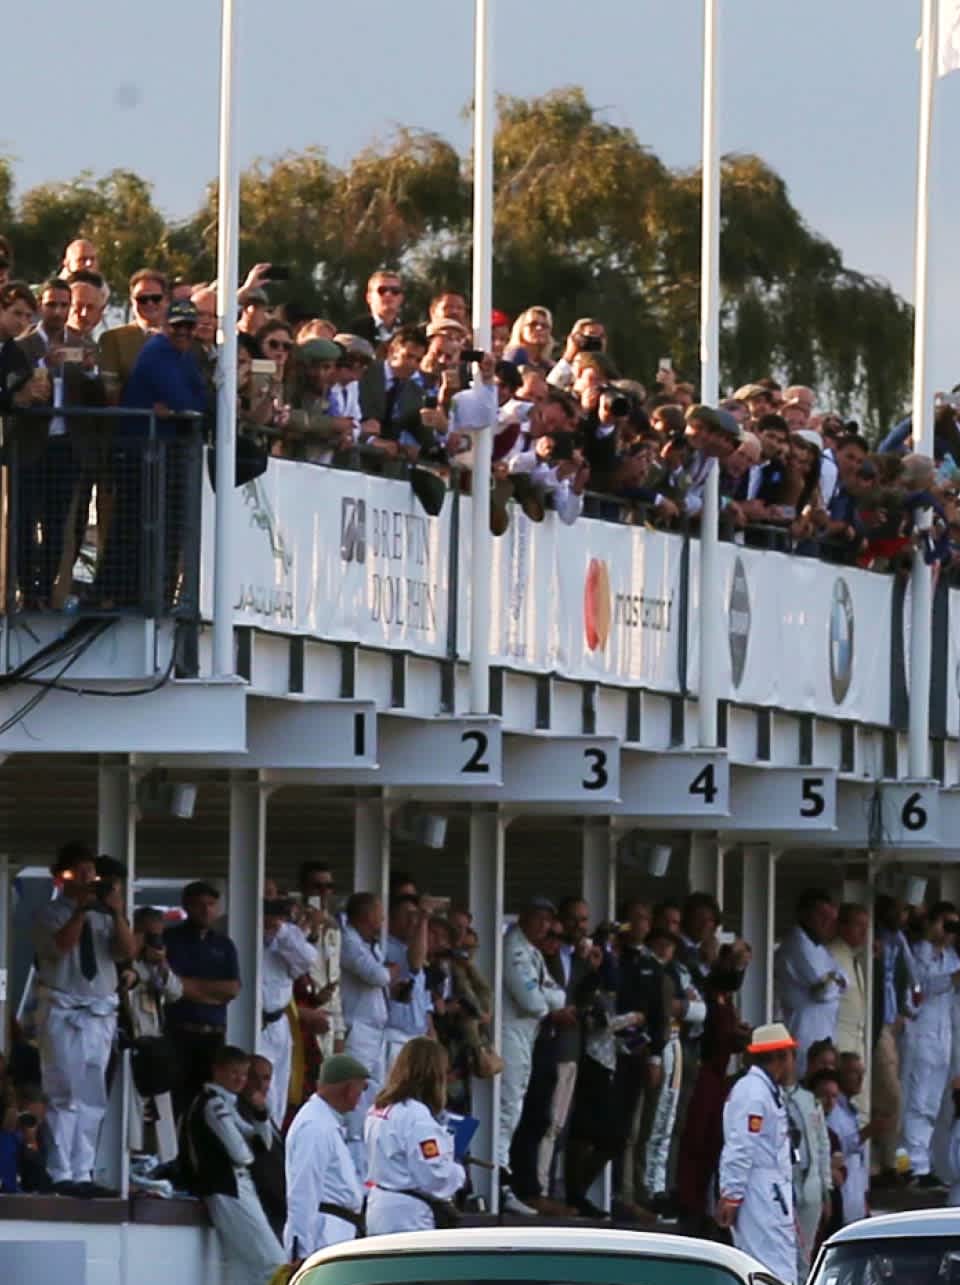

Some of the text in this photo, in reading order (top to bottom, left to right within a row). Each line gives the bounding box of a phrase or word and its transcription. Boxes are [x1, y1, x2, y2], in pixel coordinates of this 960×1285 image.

[354, 712, 365, 756] 1
[461, 730, 489, 773] 2
[581, 748, 608, 790] 3
[689, 762, 718, 804] 4
[800, 778, 825, 819] 5
[901, 791, 927, 832] 6
